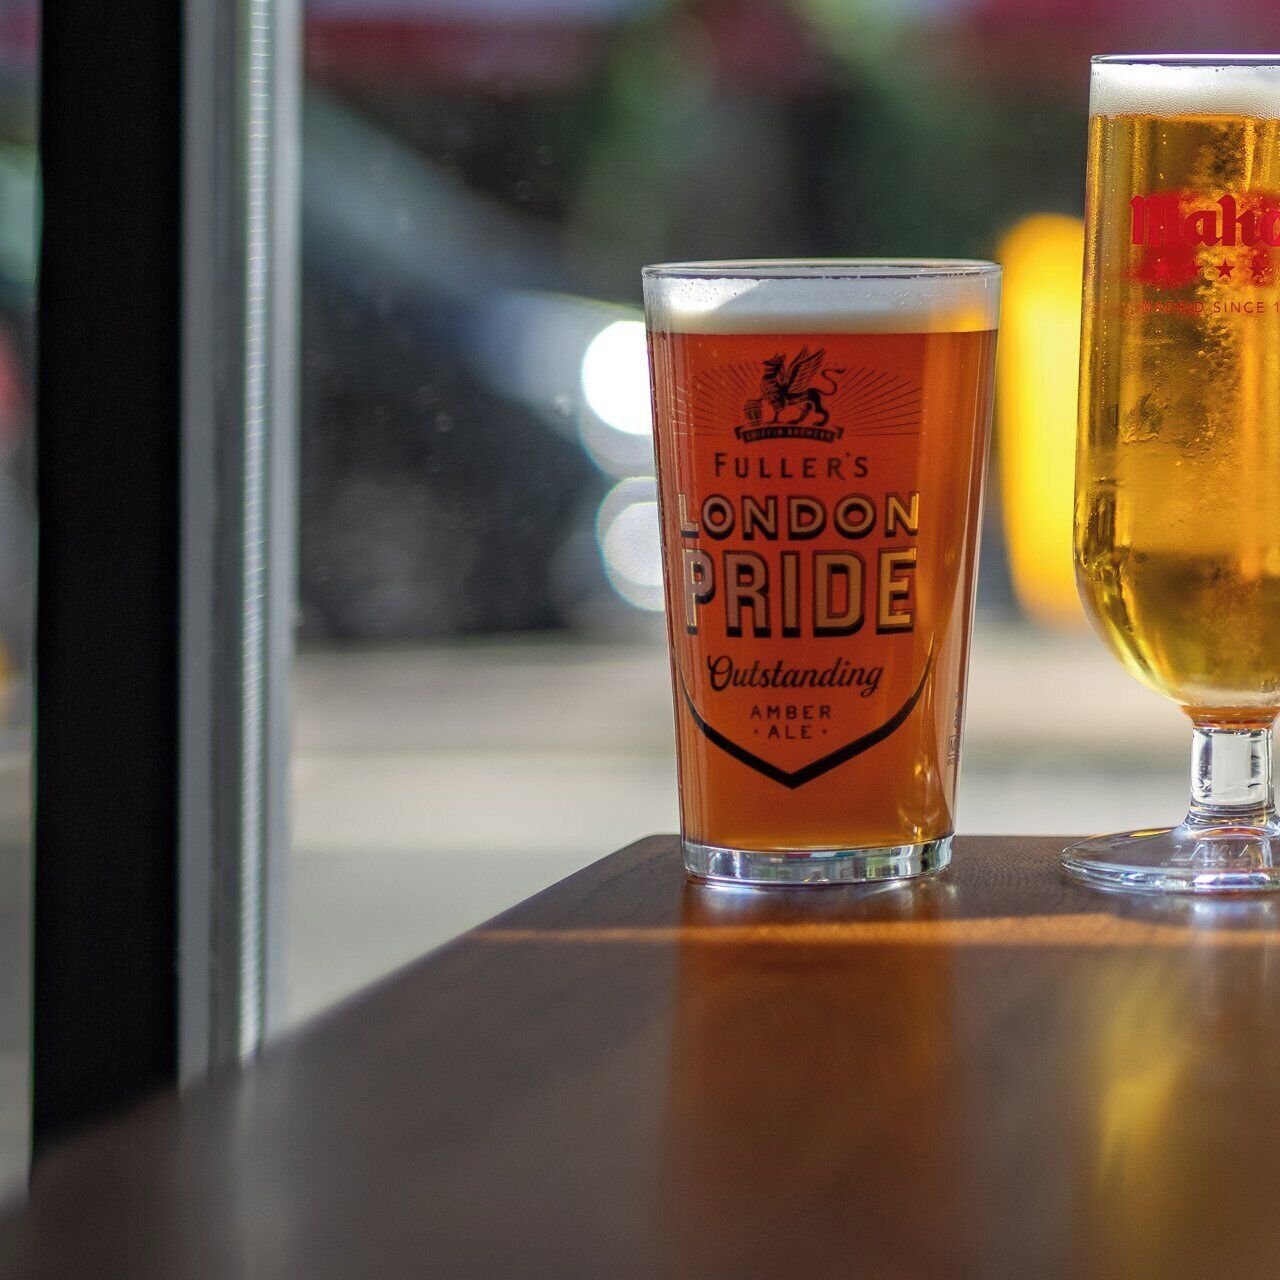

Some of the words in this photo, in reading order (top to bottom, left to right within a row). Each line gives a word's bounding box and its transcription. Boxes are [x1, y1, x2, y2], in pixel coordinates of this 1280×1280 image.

[1141, 301, 1204, 314] MADRID
[1213, 301, 1265, 313] SINCE
[714, 452, 869, 480] FULLER'S
[678, 490, 920, 541] LONDON
[682, 546, 918, 638] PRIDE
[707, 655, 885, 698] Outstanding
[750, 705, 832, 719] AMBER
[768, 725, 812, 739] ALE
